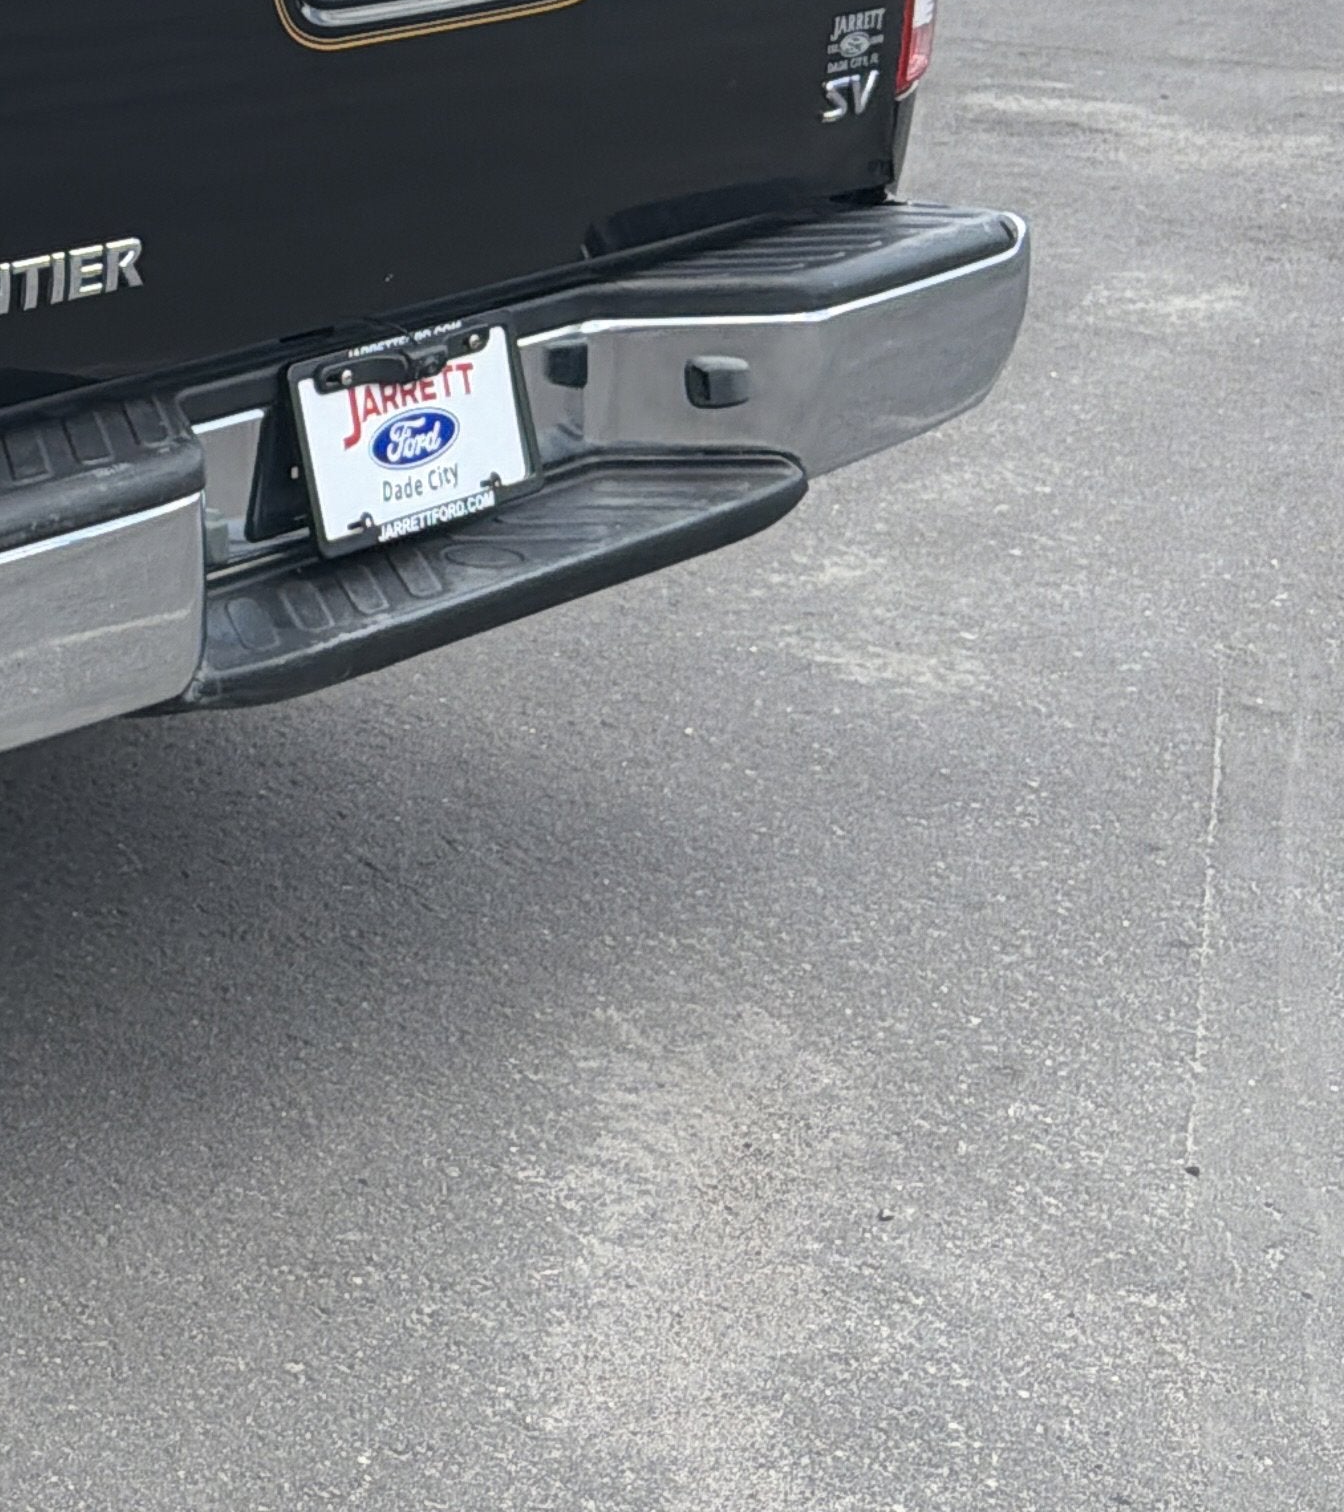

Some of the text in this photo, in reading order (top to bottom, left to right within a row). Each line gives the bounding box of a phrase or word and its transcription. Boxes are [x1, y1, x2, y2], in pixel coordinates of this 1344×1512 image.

[830, 8, 886, 42] JARRETT
[822, 70, 880, 123] SV
[343, 362, 474, 450] JARRETT
[386, 416, 443, 462] Ford
[382, 463, 459, 502] Dade City
[378, 489, 496, 542] JARRETTFORD.COM
